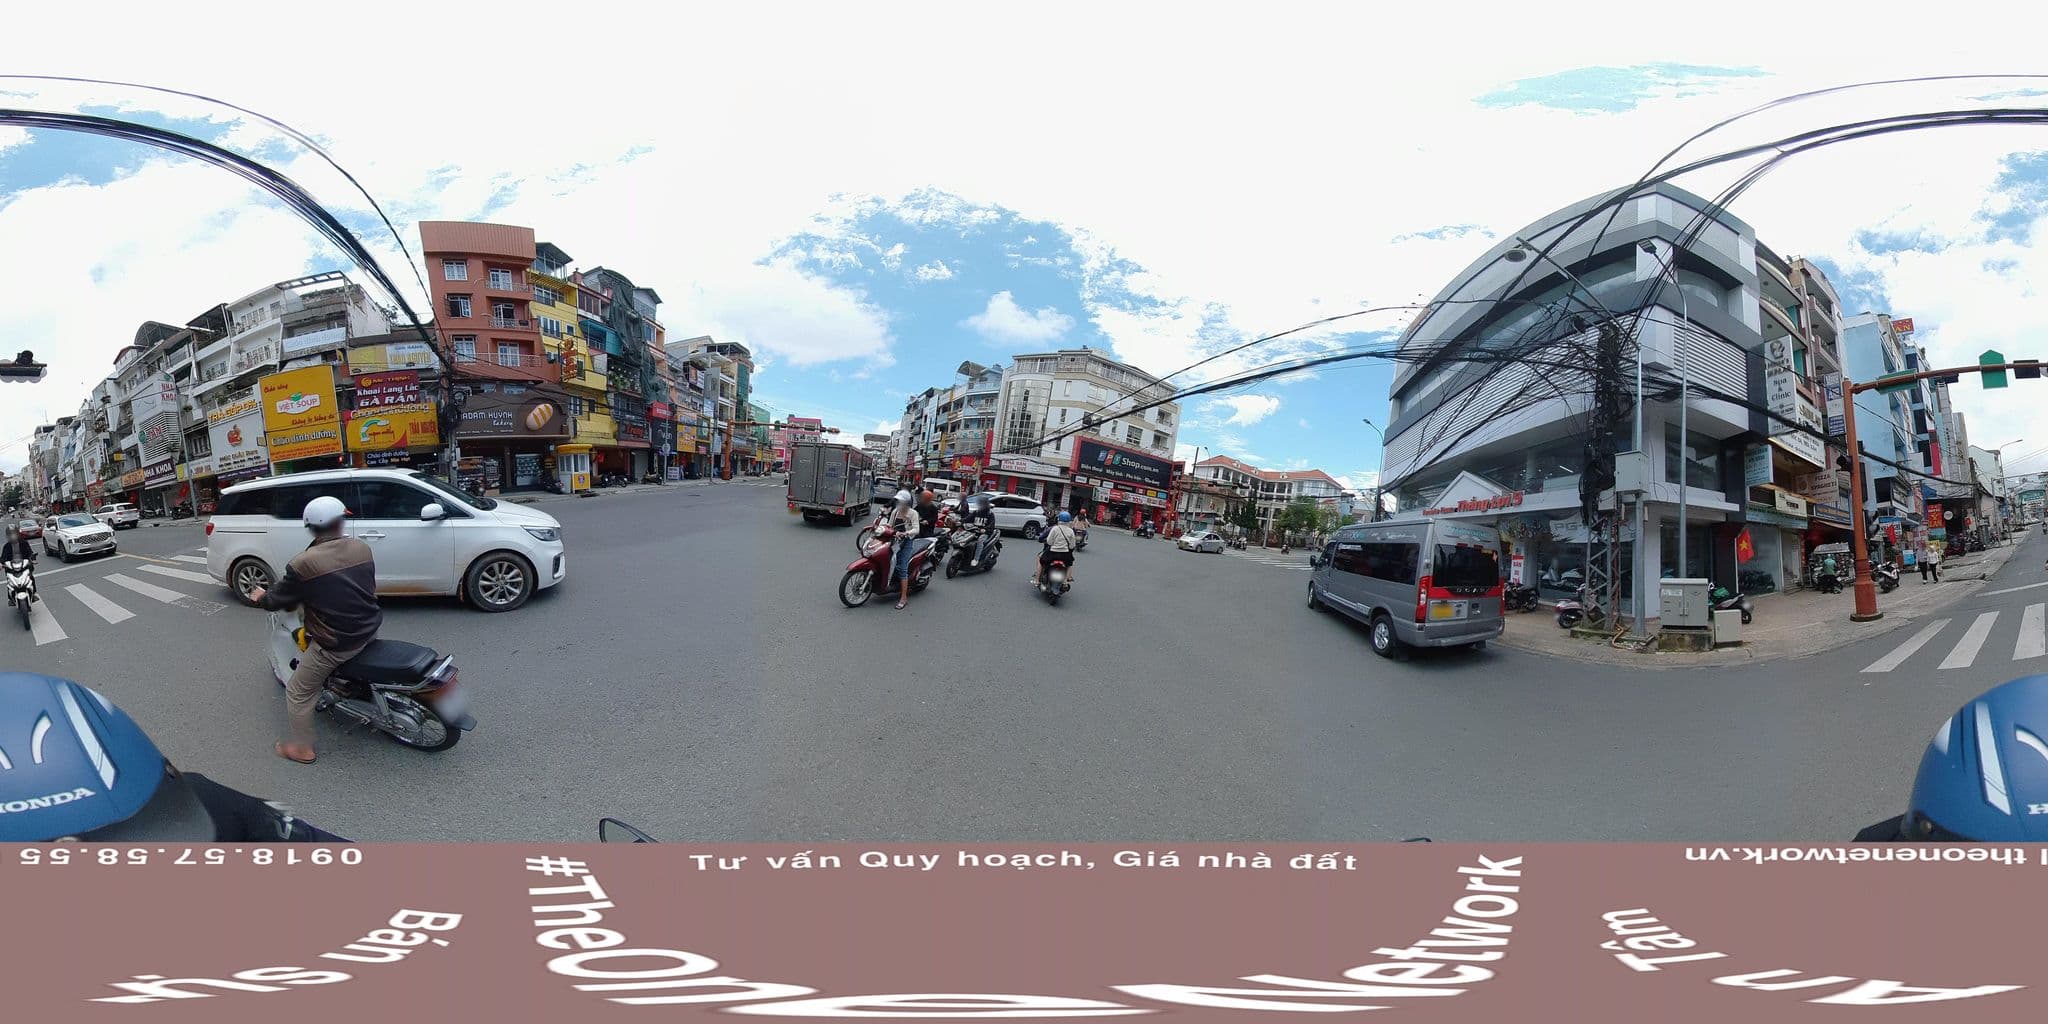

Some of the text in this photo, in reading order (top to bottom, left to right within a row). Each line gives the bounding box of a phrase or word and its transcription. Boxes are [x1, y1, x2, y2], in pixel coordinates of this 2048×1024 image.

[357, 387, 380, 396] Khoai
[383, 386, 402, 394] Lang
[278, 398, 317, 411] VIỆT SOUP
[360, 393, 416, 406] GÀ RÁN
[1122, 458, 1159, 473] Shop.com.vn
